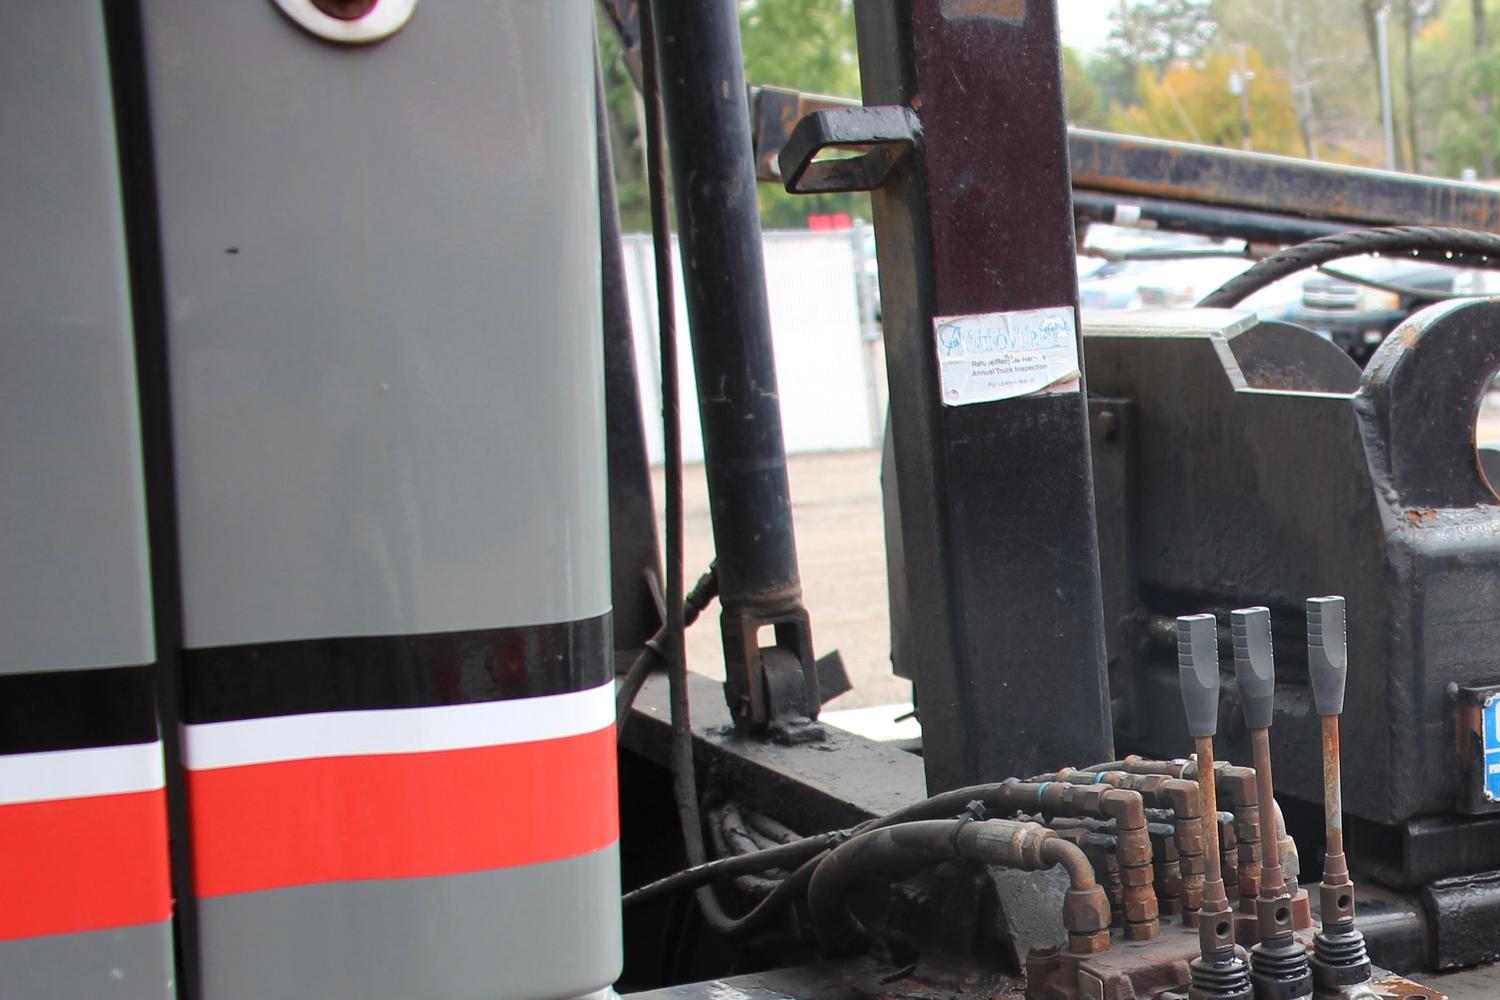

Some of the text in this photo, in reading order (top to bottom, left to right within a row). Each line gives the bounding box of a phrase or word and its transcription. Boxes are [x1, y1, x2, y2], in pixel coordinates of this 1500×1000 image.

[972, 364, 1048, 377] Annual Truck Inspection
